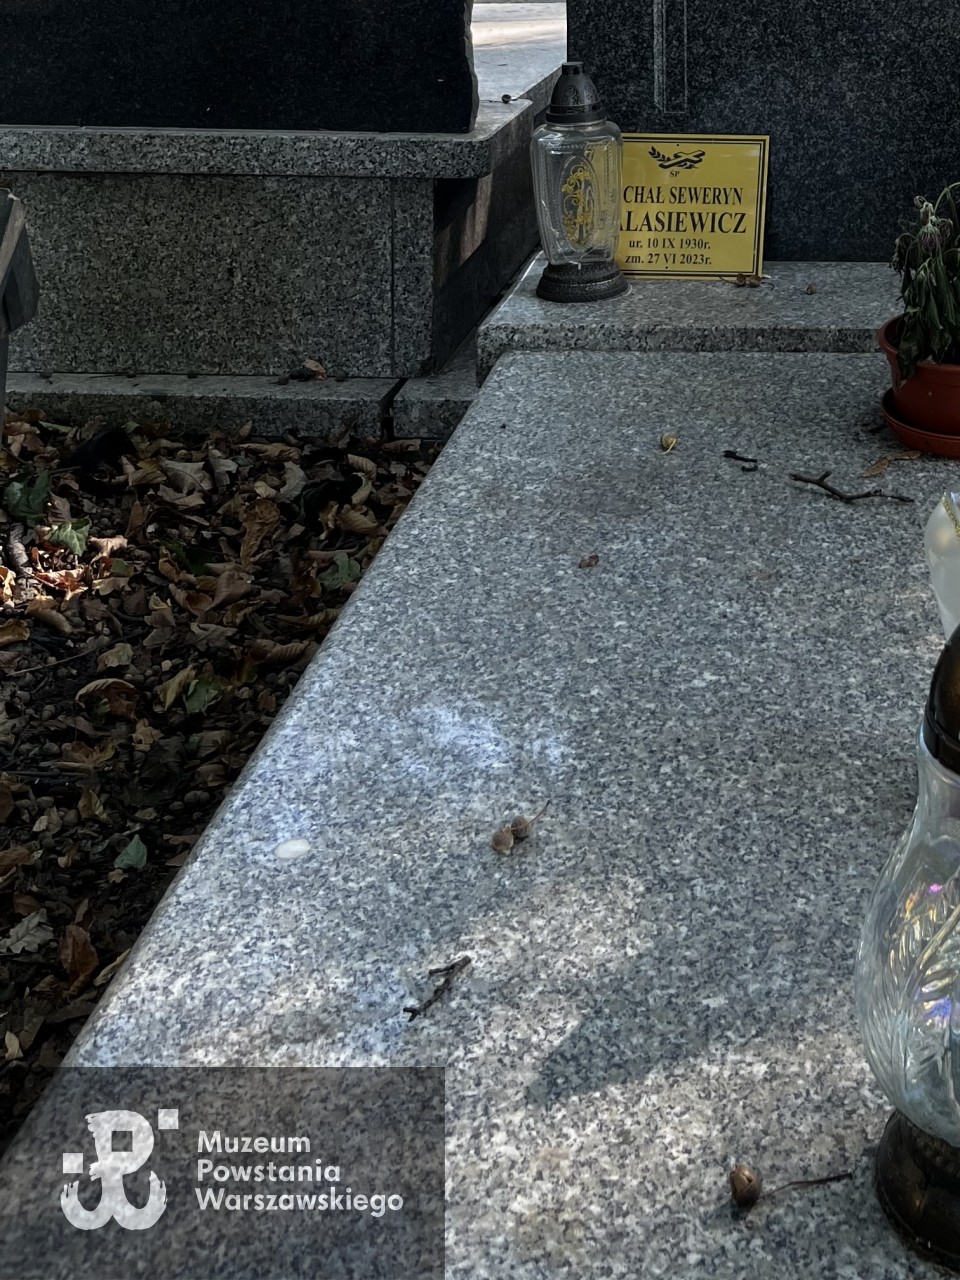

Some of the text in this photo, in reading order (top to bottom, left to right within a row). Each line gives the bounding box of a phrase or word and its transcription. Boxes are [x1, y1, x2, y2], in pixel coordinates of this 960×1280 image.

[622, 185, 744, 206] CHAŁ SEWERYN
[619, 211, 748, 235] LASIEWICZ
[628, 238, 711, 251] ur. 10 IX 1930r.
[624, 253, 713, 266] zm. 27 VI 2023r.
